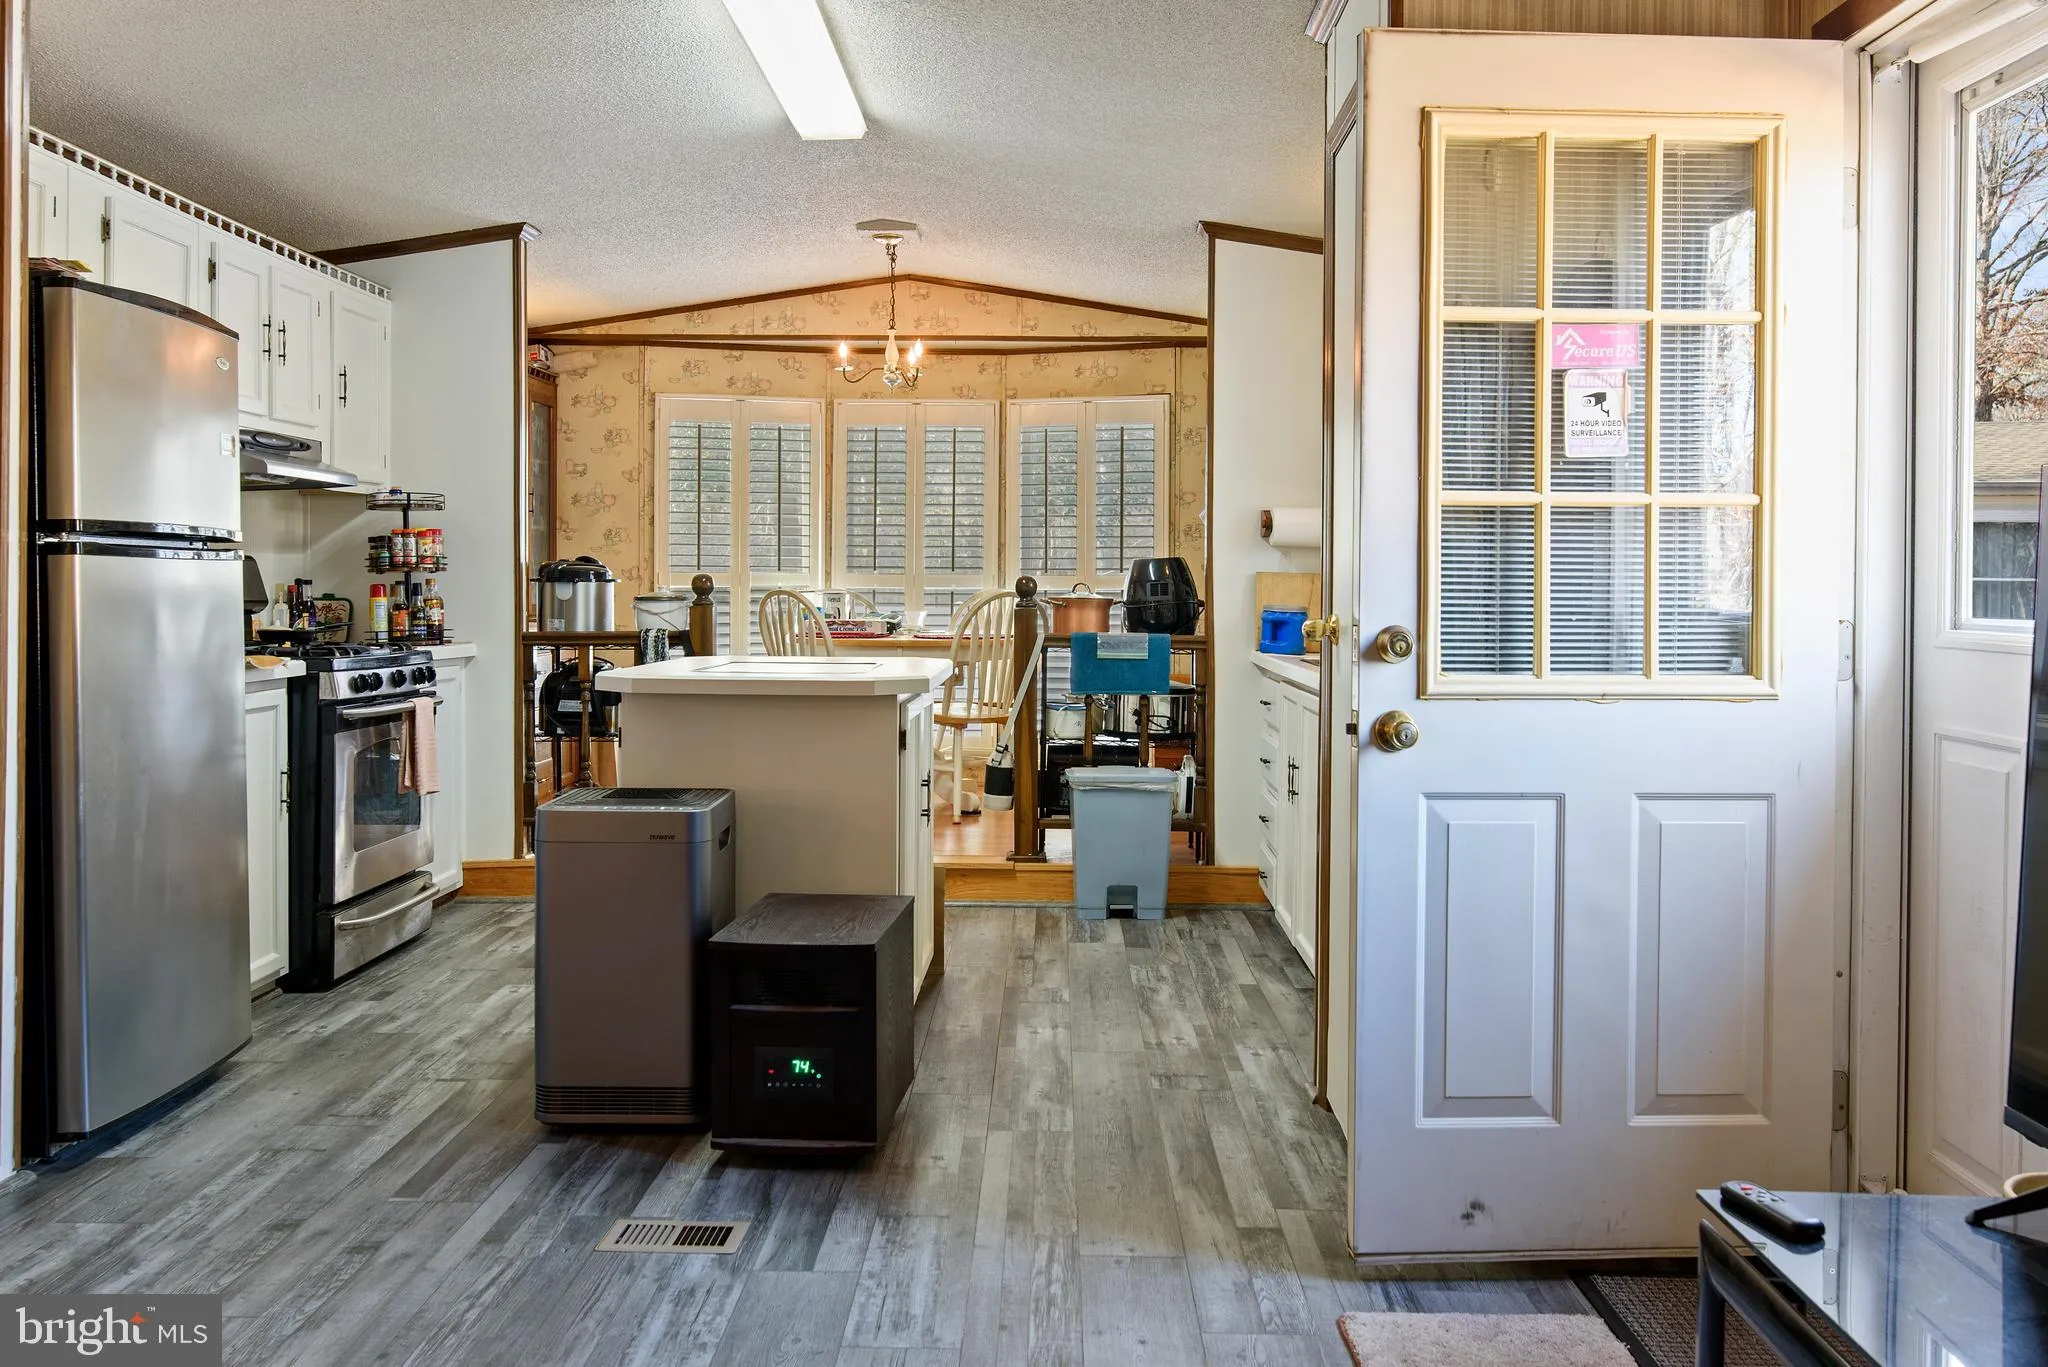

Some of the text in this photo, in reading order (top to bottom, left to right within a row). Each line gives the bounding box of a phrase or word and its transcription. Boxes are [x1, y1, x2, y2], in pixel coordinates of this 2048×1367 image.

[1568, 375, 1623, 387] WARNING
[1571, 429, 1622, 437] SURVEILLANCE
[792, 1060, 810, 1073] 74
